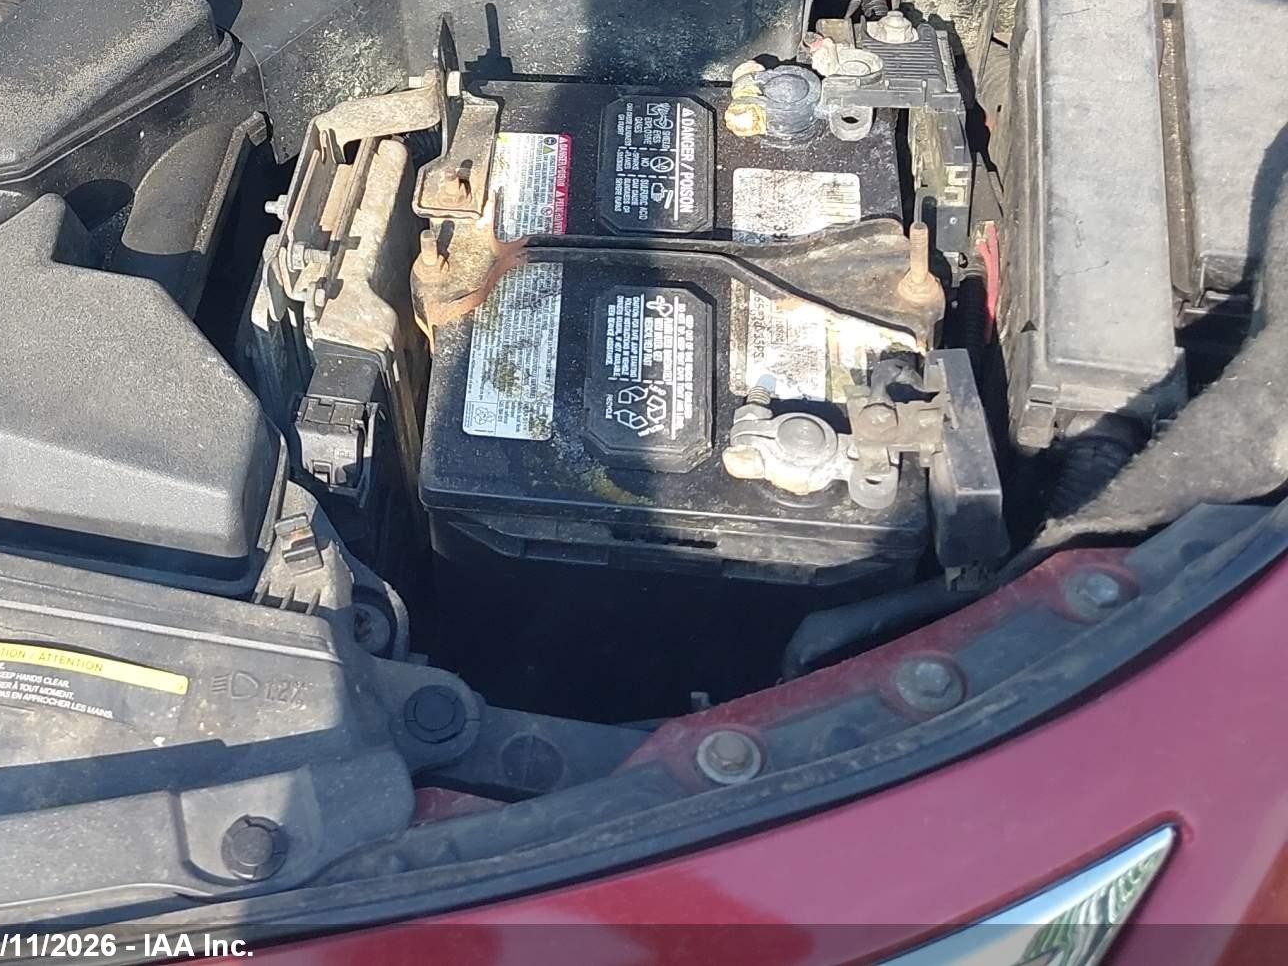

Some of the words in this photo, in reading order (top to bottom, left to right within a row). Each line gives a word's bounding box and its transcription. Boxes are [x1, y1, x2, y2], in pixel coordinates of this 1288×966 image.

[681, 119, 695, 161] DANGER
[641, 158, 649, 167] NO
[680, 172, 694, 213] POISON
[605, 394, 613, 419] RECYCLE
[38, 654, 104, 672] ATTENTION
[16, 672, 42, 683] HANDS
[19, 683, 40, 692] TOUT
[22, 694, 70, 708] APPROCHER
[71, 702, 86, 712] LES
